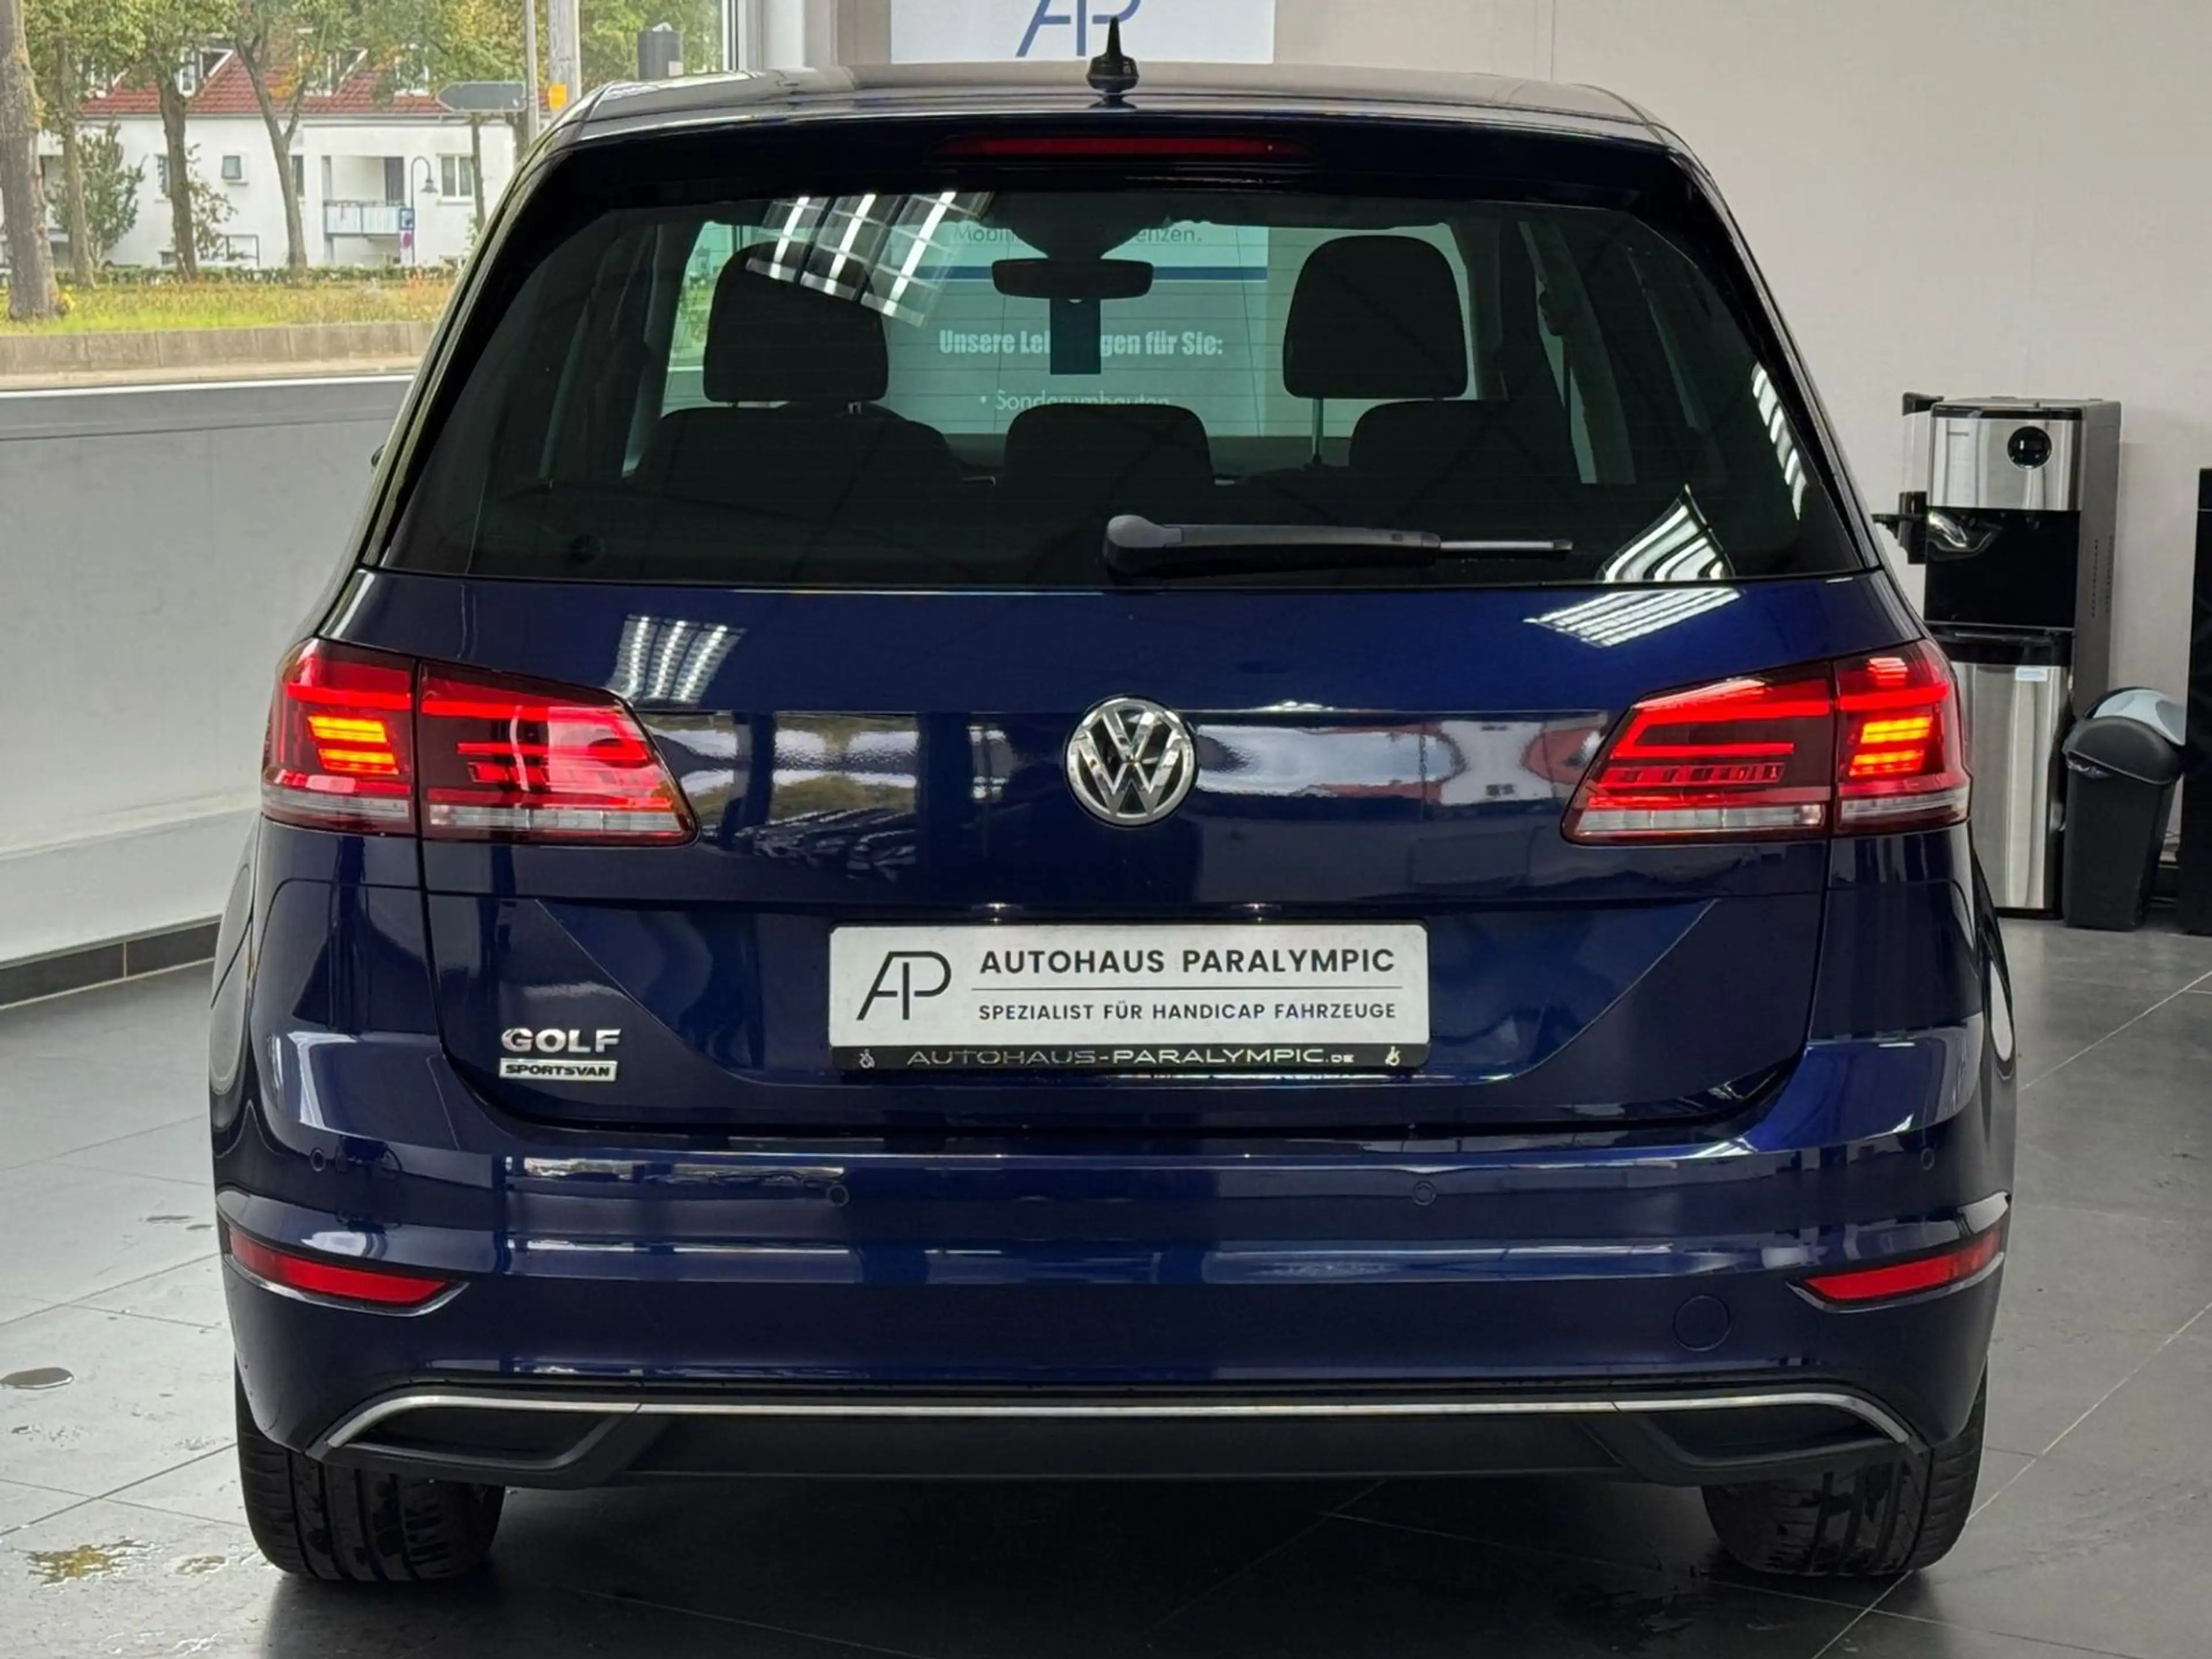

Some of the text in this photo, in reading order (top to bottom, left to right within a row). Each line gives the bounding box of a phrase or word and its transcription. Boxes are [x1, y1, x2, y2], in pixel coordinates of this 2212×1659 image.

[939, 329, 1224, 357] Unsere Leigen für Sie:
[980, 949, 1395, 974] AUTOHAUS PARALYMPIC
[979, 1000, 1396, 1020] SPEZIALIST FÜR HANDICAP FAHRZEUGE
[501, 1028, 621, 1052] GOLF
[506, 1065, 609, 1076] SPORTSVAN
